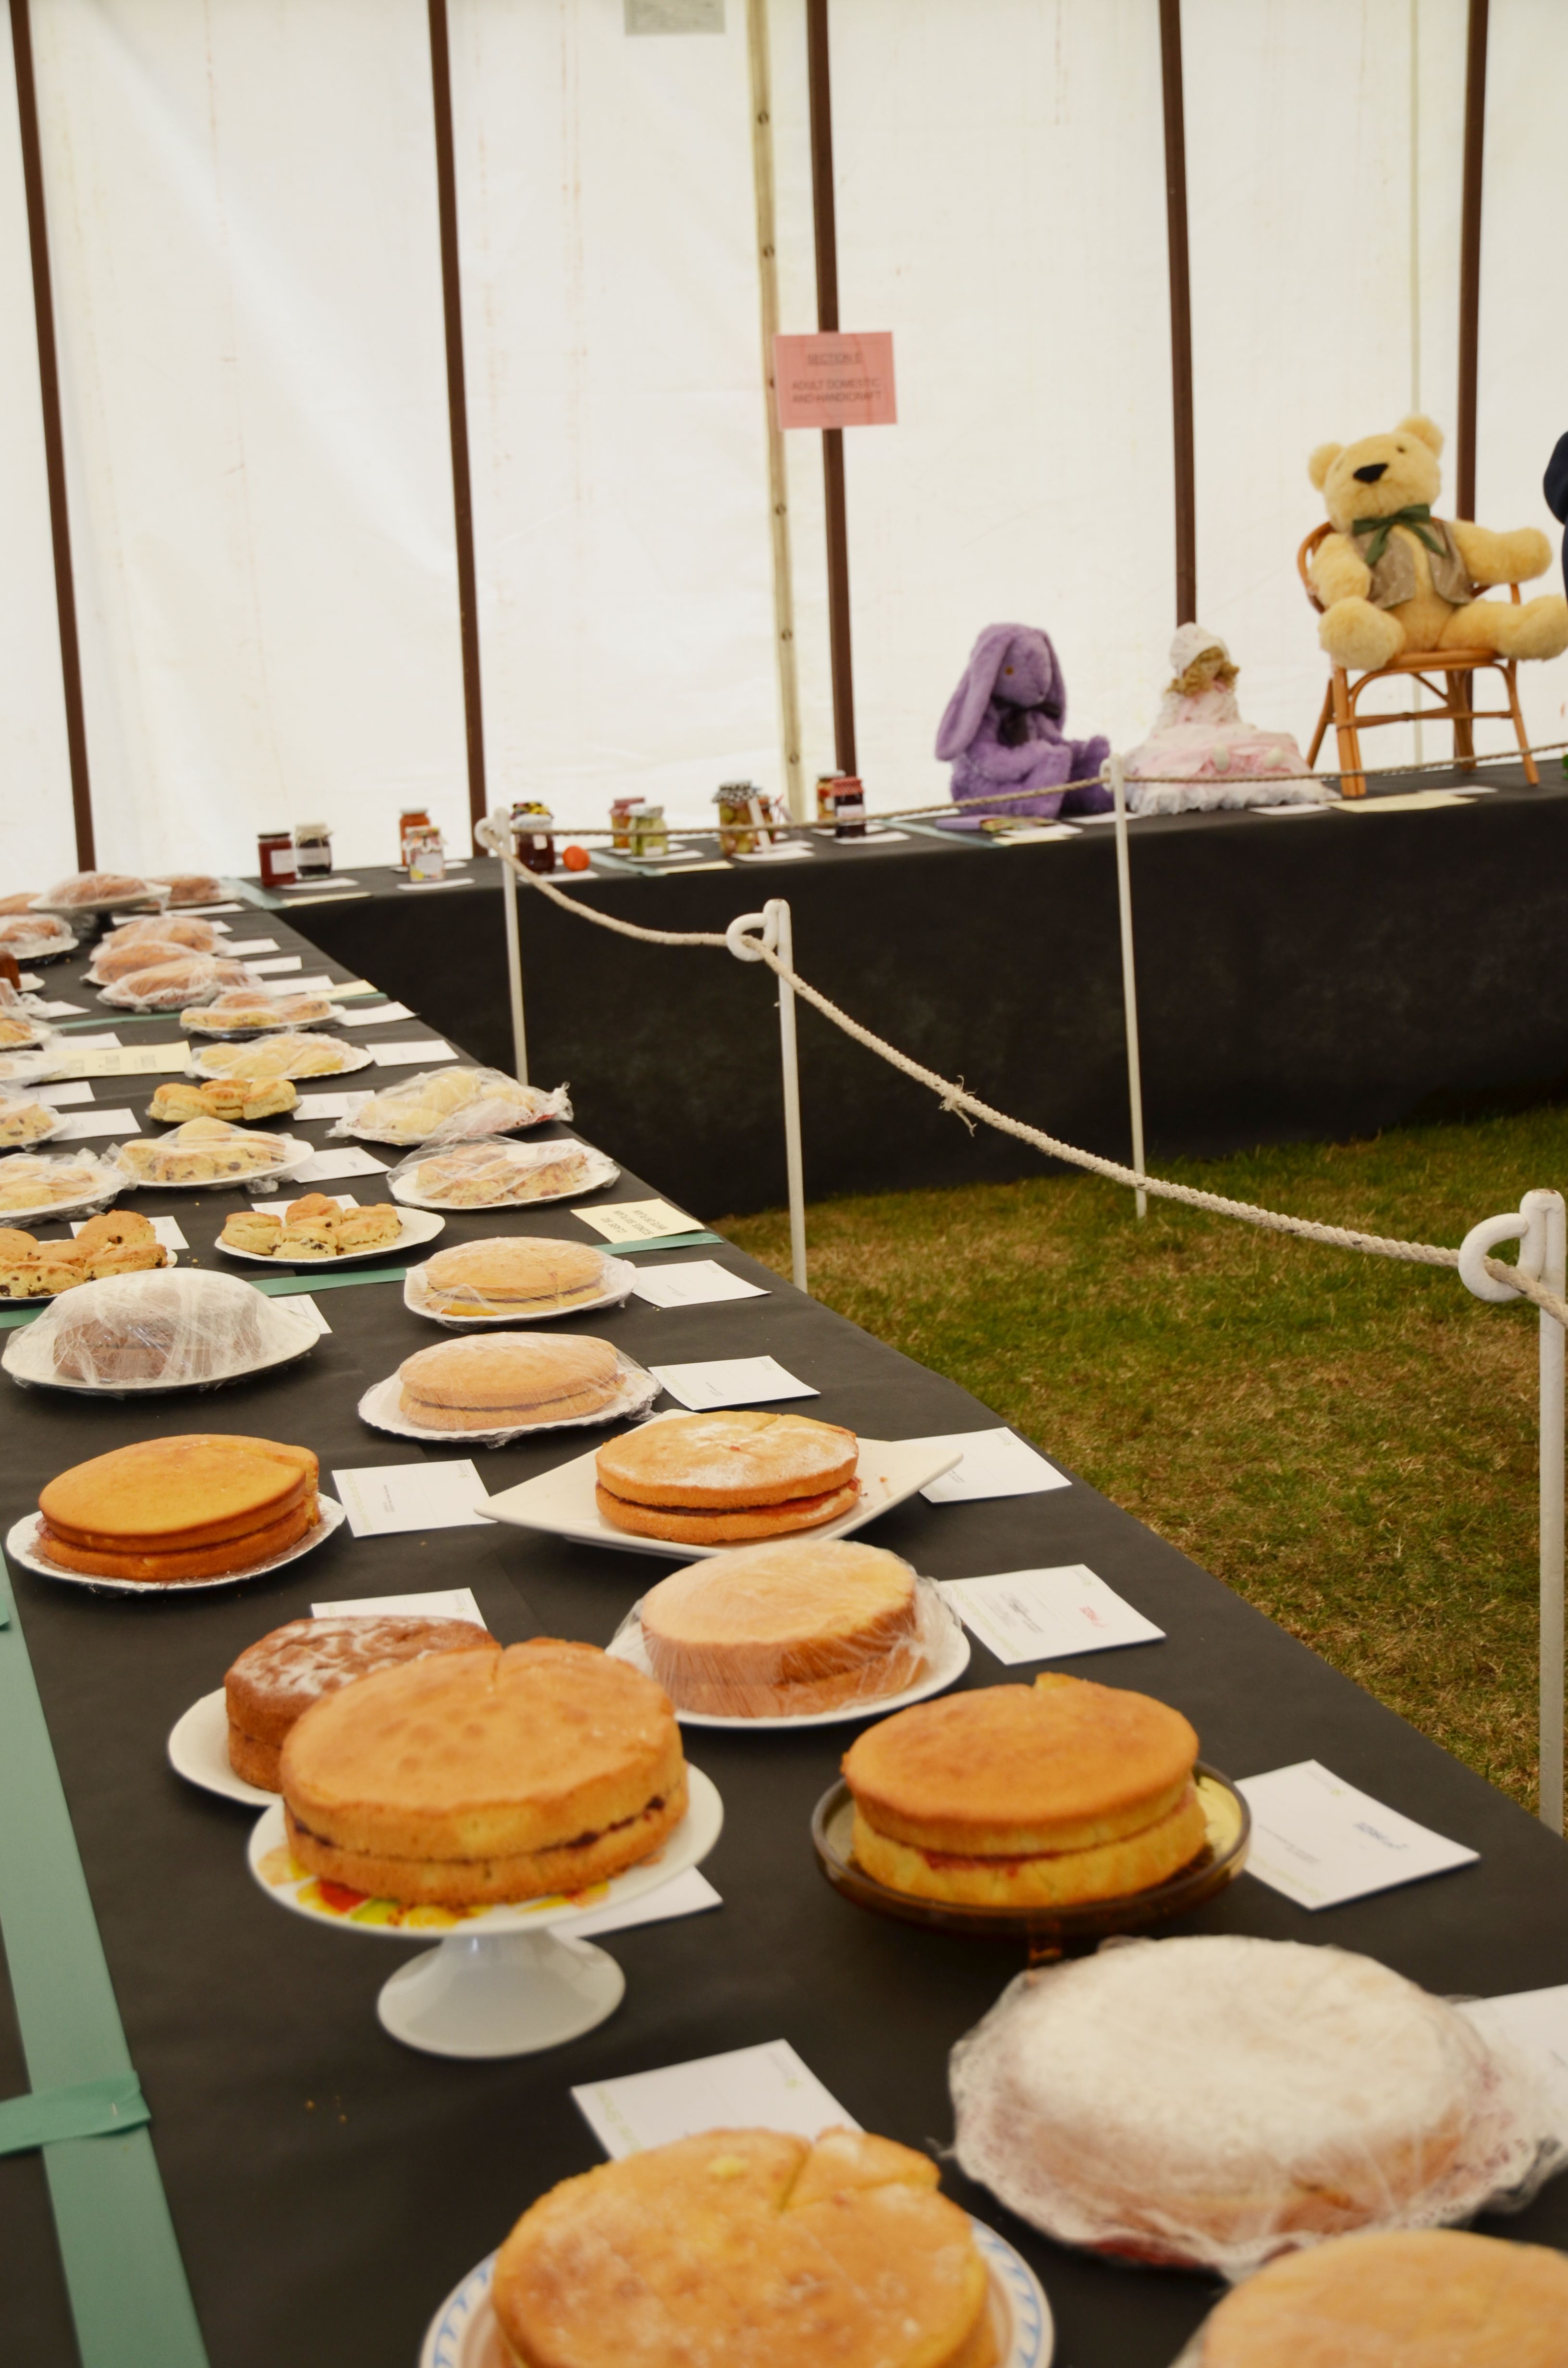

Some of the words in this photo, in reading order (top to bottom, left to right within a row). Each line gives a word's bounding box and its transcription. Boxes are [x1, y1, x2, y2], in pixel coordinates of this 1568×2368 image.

[792, 379, 822, 390] ADULT
[826, 378, 882, 388] DOMESTIC
[792, 393, 813, 403] AND
[816, 391, 881, 402] HANDICRAFT
